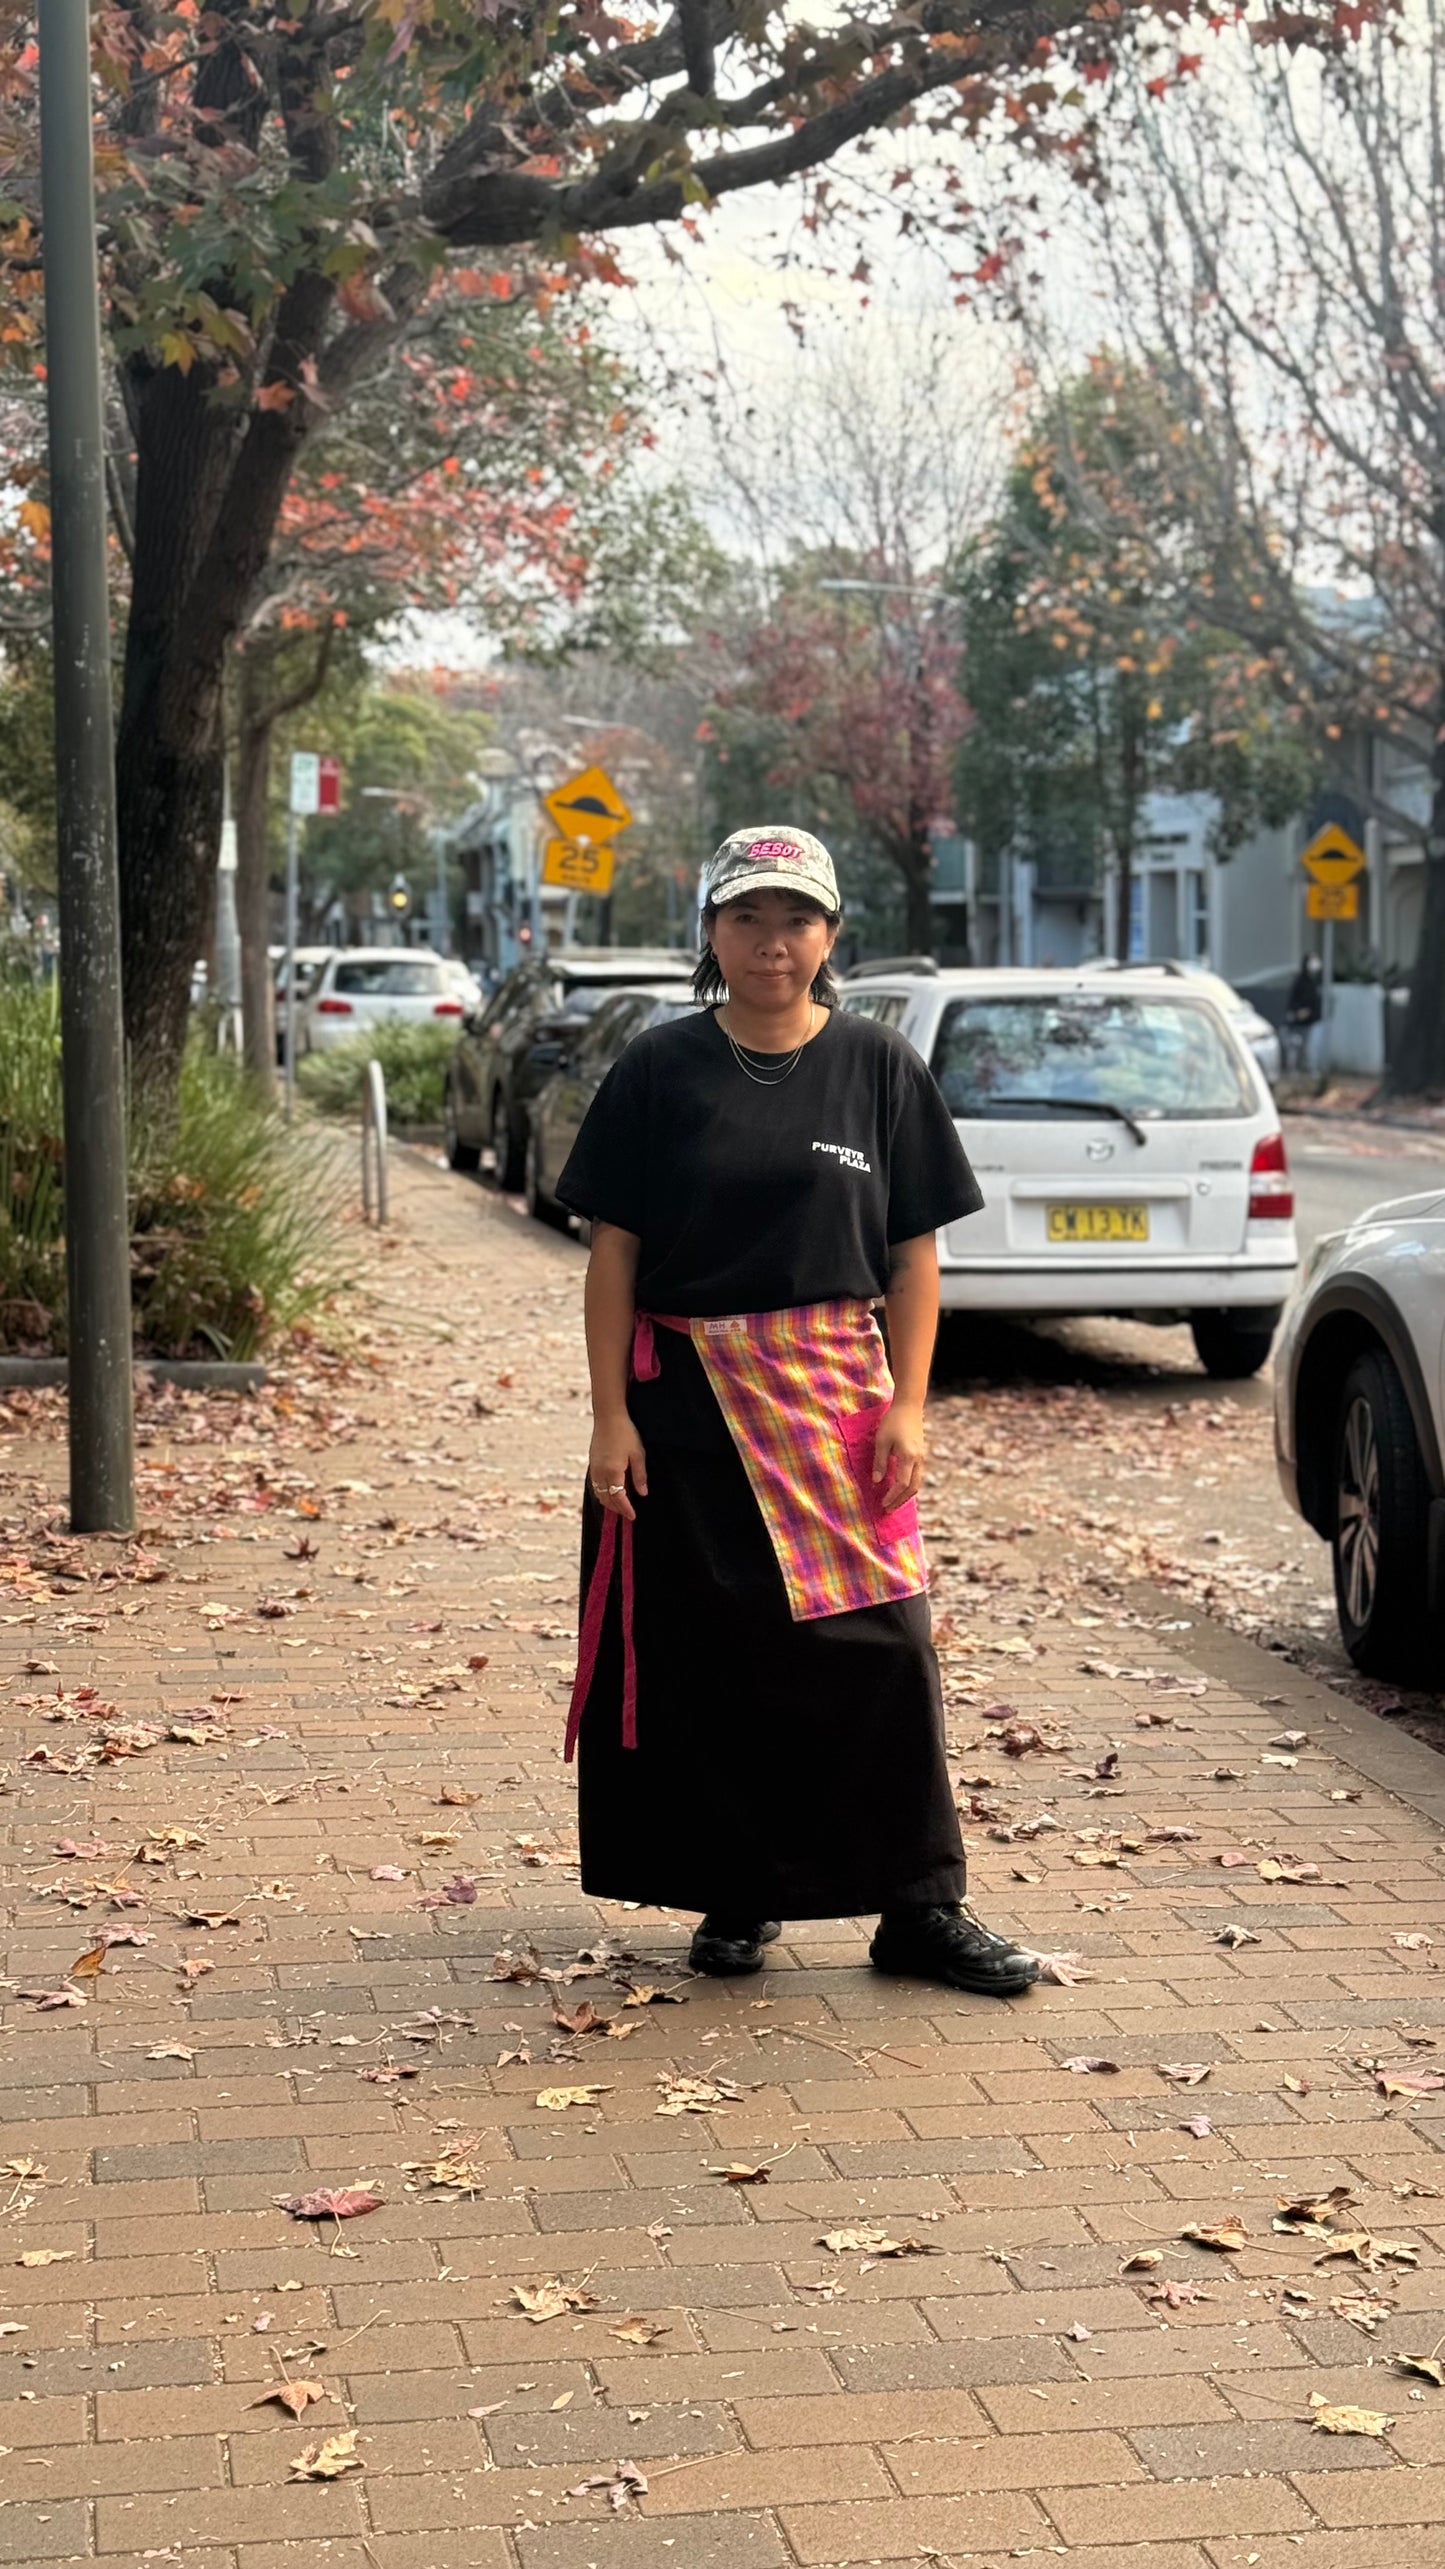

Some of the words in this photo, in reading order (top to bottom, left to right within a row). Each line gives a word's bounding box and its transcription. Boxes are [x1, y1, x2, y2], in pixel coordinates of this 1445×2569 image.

[748, 841, 804, 859] BEBOT
[559, 846, 599, 875] 25
[812, 1141, 865, 1161] PURVEYR
[840, 1155, 871, 1173] PLAZA
